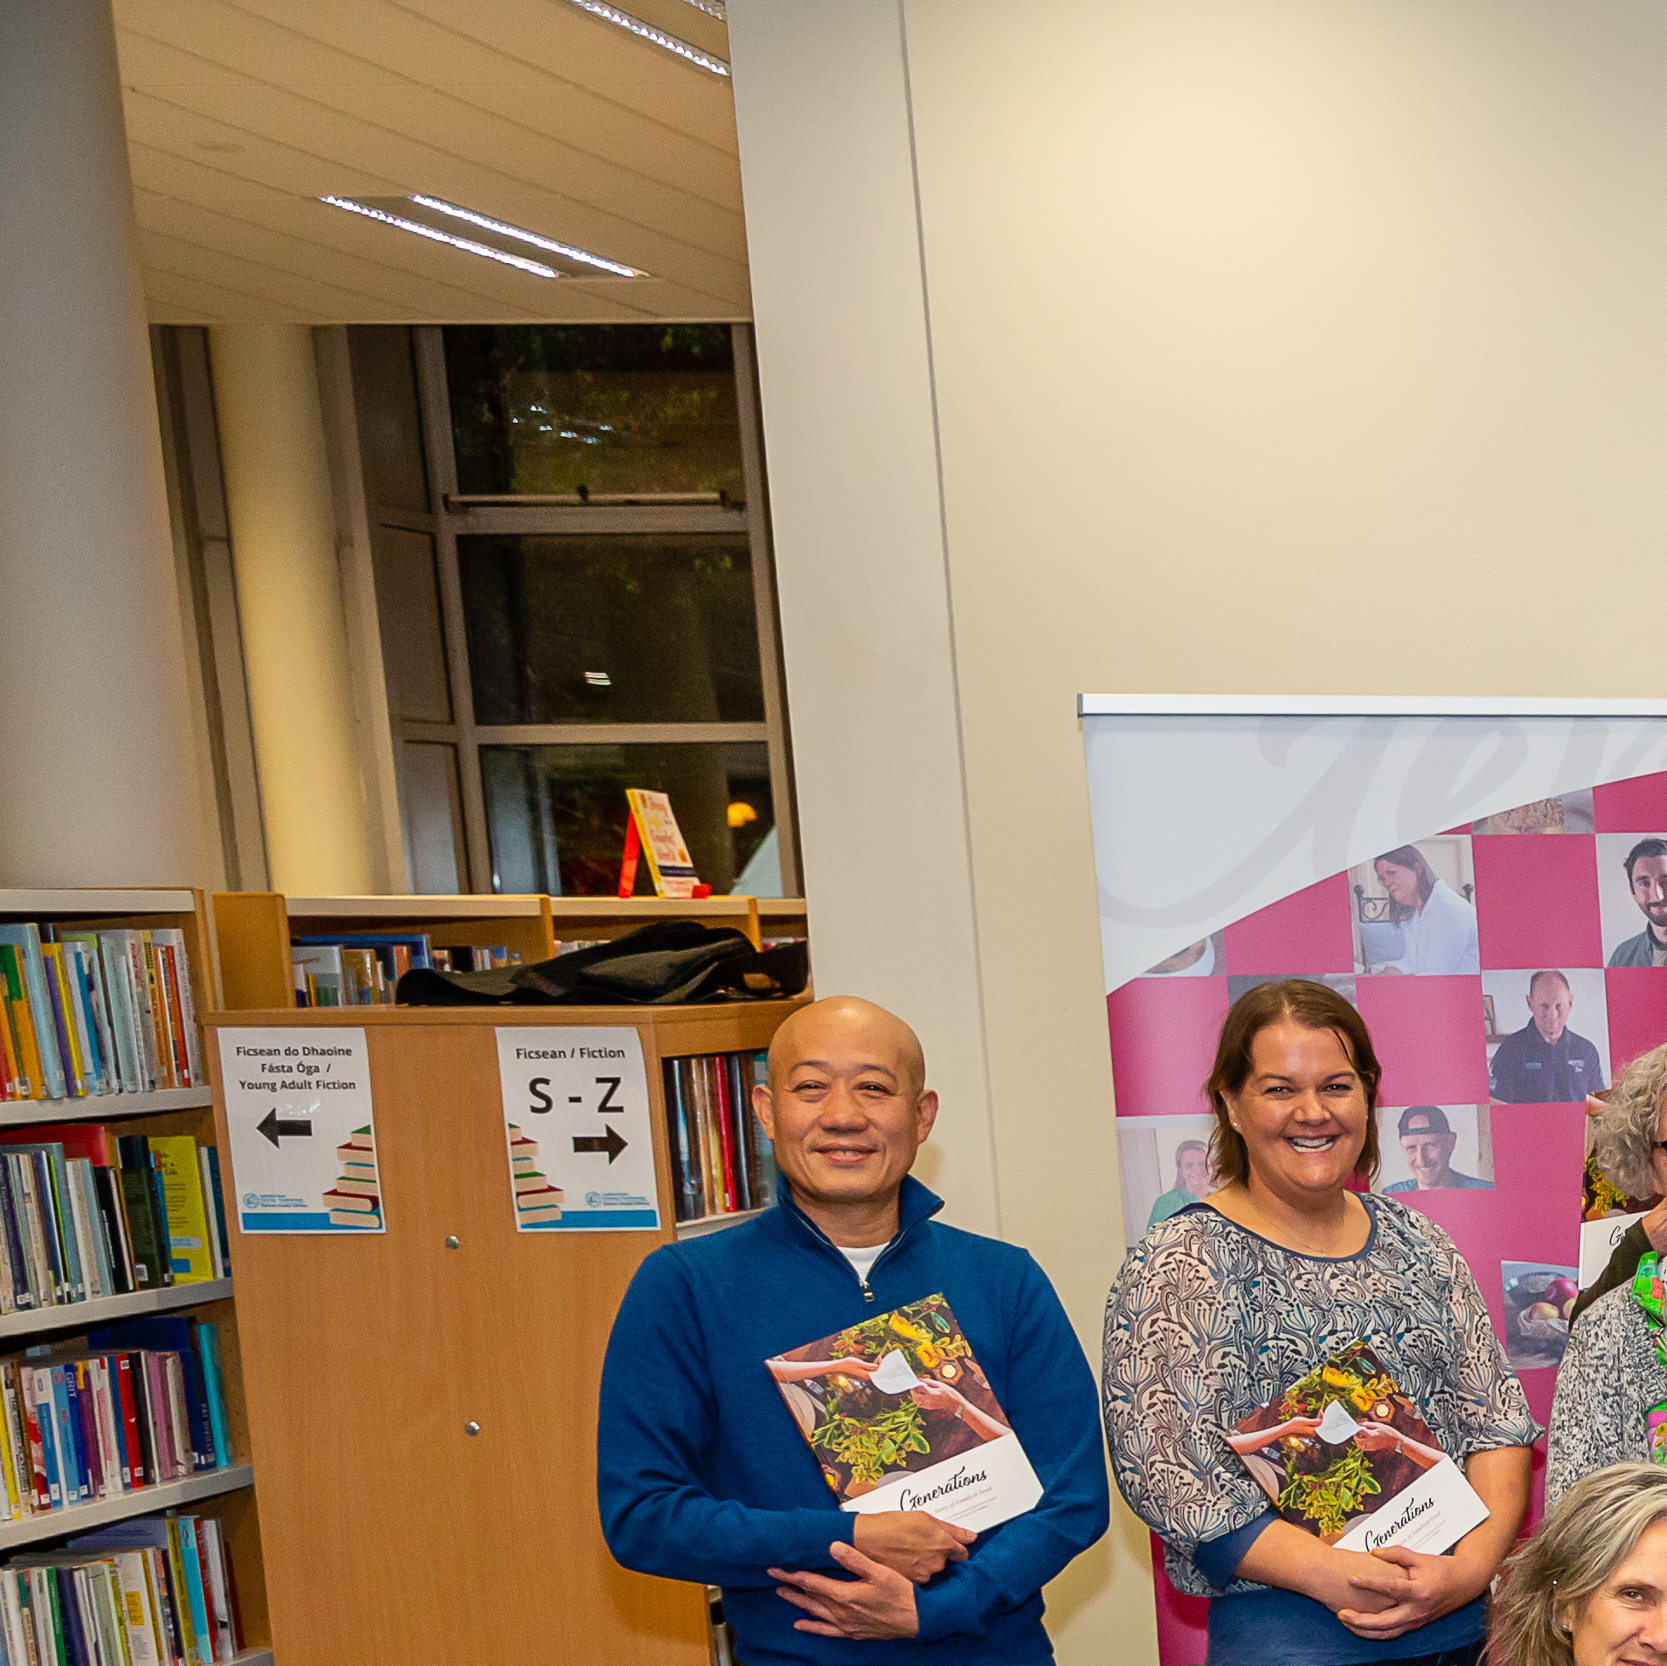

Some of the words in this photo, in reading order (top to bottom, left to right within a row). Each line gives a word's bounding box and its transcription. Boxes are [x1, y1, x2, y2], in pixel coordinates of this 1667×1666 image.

[236, 1046, 281, 1056] Ficsean
[284, 1046, 299, 1056] do
[302, 1046, 352, 1056] Dhaoine
[516, 1048, 566, 1059] Ficsean
[570, 1048, 575, 1058] /
[580, 1048, 625, 1058] Fiction
[261, 1063, 293, 1073] Fásta
[297, 1062, 319, 1075] Óga
[240, 1080, 277, 1092] Young
[280, 1080, 311, 1090] Adult
[316, 1080, 356, 1090] Fiction
[529, 1077, 553, 1114] S
[595, 1077, 624, 1113] Z
[65, 1371, 77, 1398] GRIT
[900, 1466, 988, 1511] Generations
[1365, 1497, 1435, 1552] Generations
